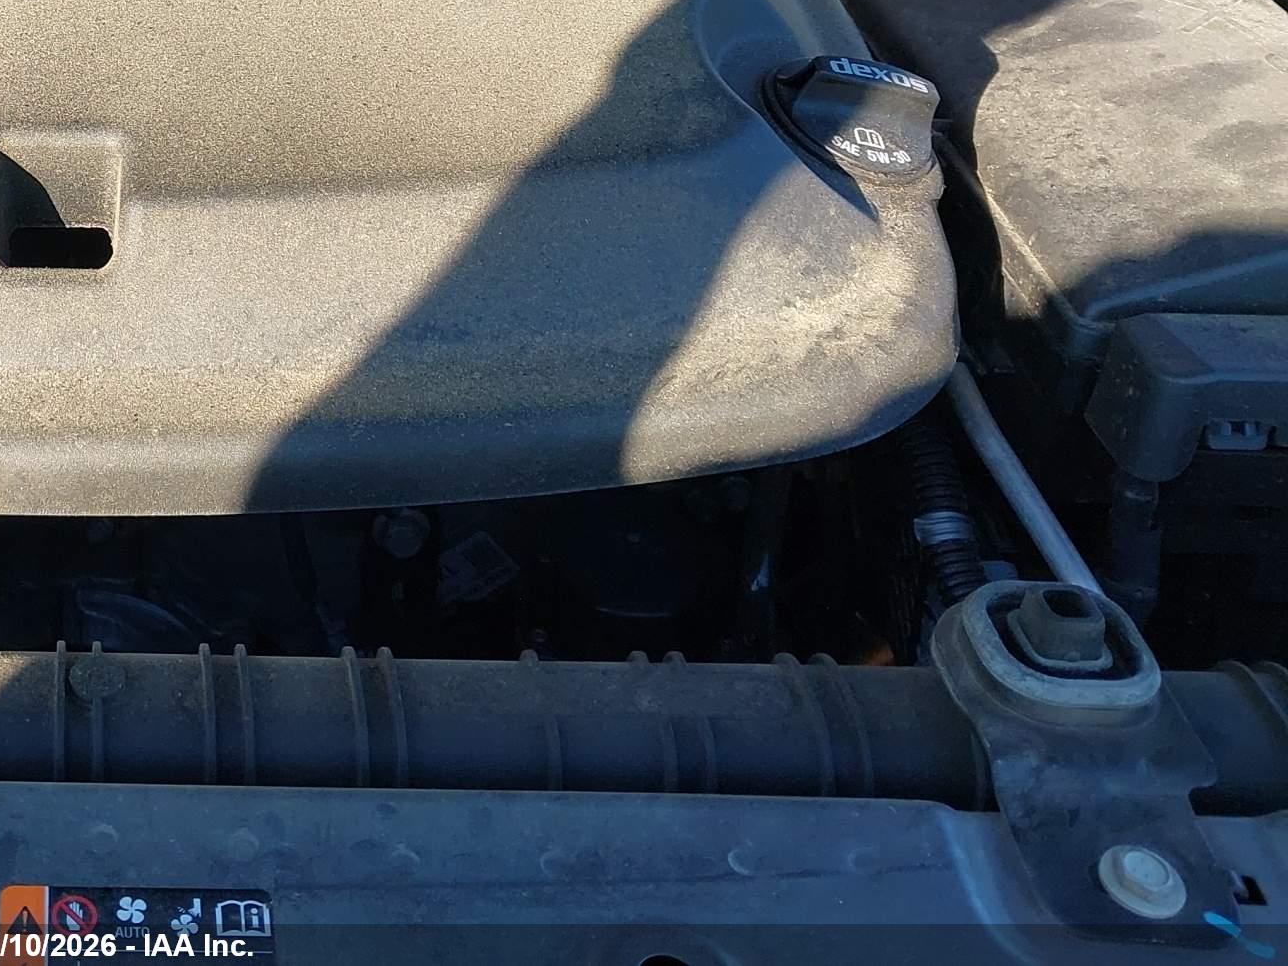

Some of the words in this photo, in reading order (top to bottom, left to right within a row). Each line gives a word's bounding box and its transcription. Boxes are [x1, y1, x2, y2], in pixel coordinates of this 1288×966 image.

[829, 57, 929, 94] dexos
[831, 135, 861, 157] SAE
[866, 149, 912, 164] 5W-30
[115, 926, 150, 939] AUTO
